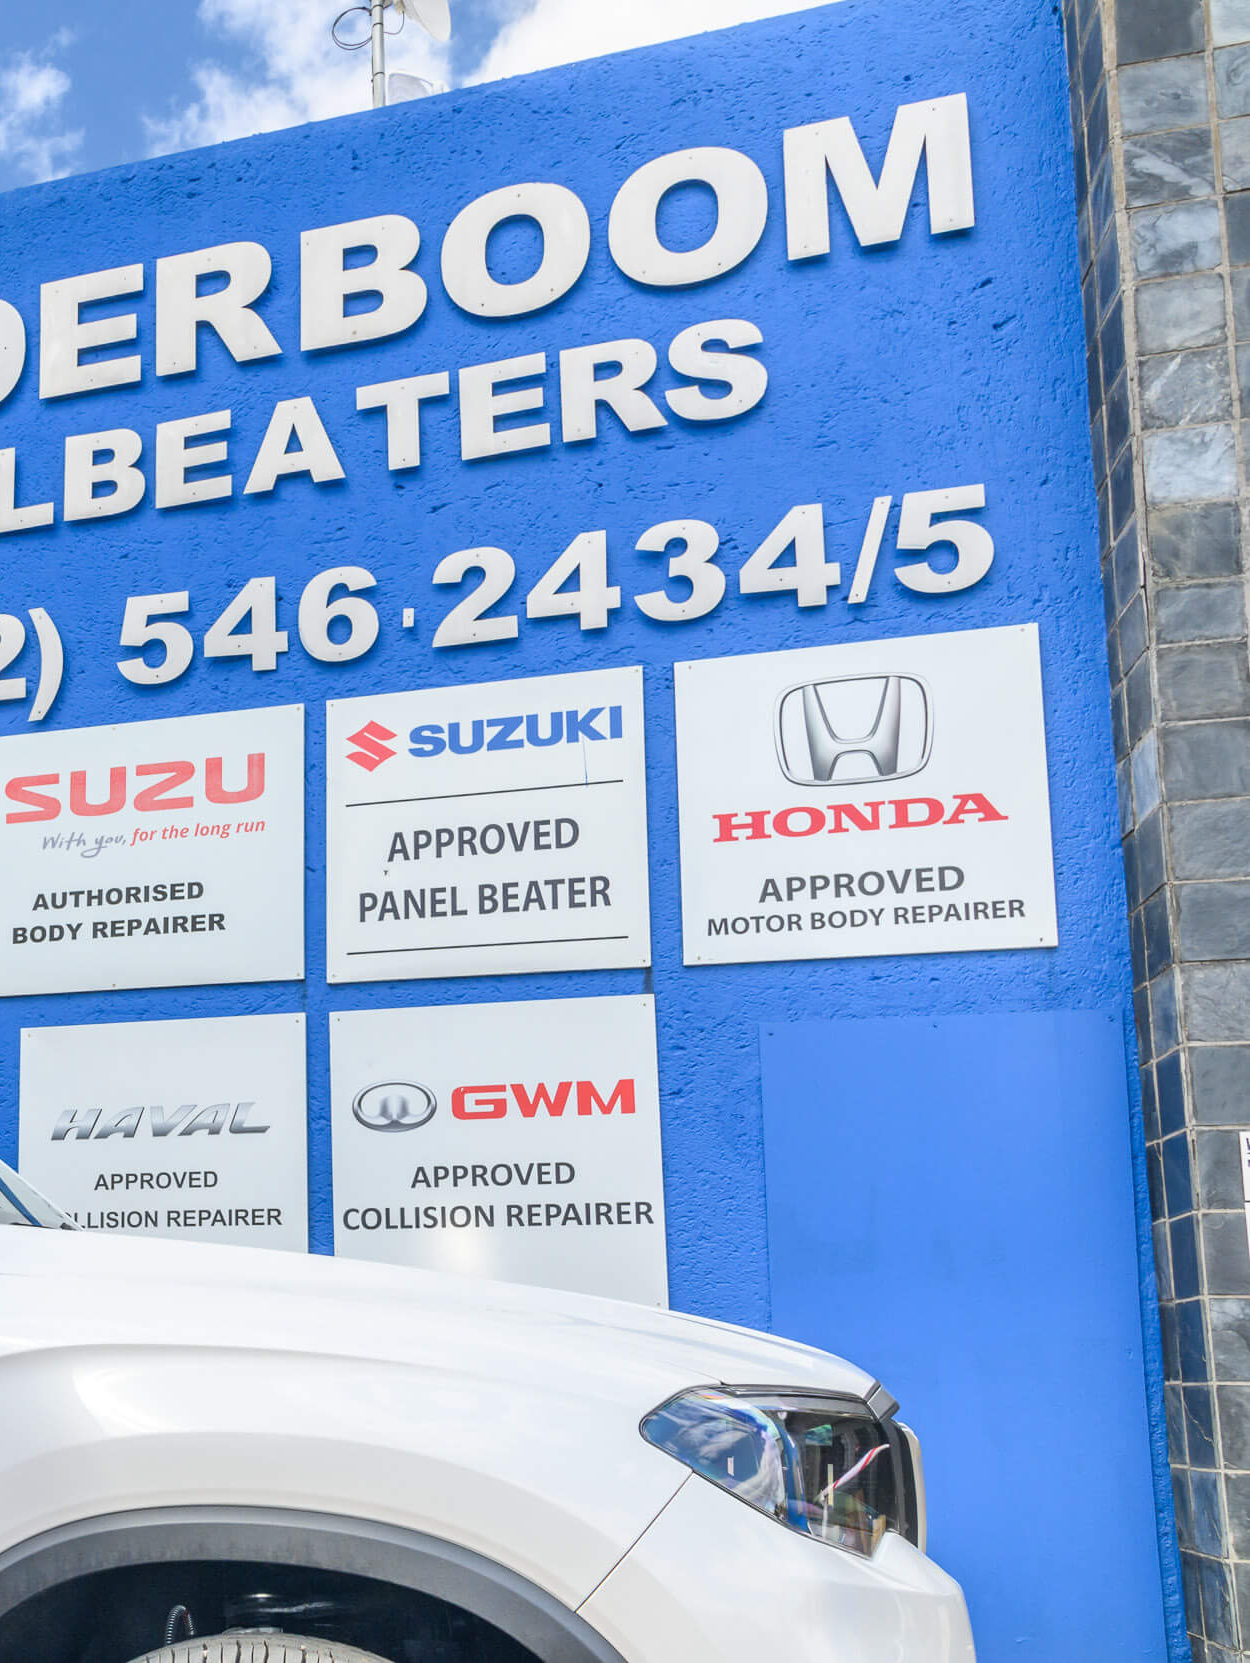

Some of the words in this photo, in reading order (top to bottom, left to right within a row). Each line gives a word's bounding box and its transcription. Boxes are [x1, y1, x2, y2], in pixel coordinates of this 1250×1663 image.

[408, 705, 623, 758] SUZUKI
[712, 792, 1009, 843] HONDA
[42, 831, 86, 850] With
[80, 832, 127, 858] you,
[130, 828, 158, 847] for
[161, 823, 189, 840] the
[194, 820, 231, 840] long
[236, 819, 266, 834] run
[387, 817, 580, 863] APPROVED
[32, 881, 204, 911] AUTHORISED
[358, 886, 468, 923] PANEL
[478, 875, 612, 915] BEATER
[759, 865, 966, 904] APPROVED
[12, 922, 83, 945] BODY
[91, 913, 226, 939] REPAIRER
[707, 913, 803, 937] MOTOR
[810, 907, 886, 931] BODY
[893, 899, 1026, 925] REPAIRER
[451, 1078, 636, 1121] GWM
[51, 1102, 271, 1141] HAVAL
[94, 1171, 219, 1191] APPROVED
[411, 1162, 576, 1189] APPROVED
[65, 1210, 159, 1229] LLISION
[167, 1208, 283, 1228] REPAIRER
[342, 1205, 495, 1230] COLLISION
[506, 1201, 655, 1228] REPAIRER
